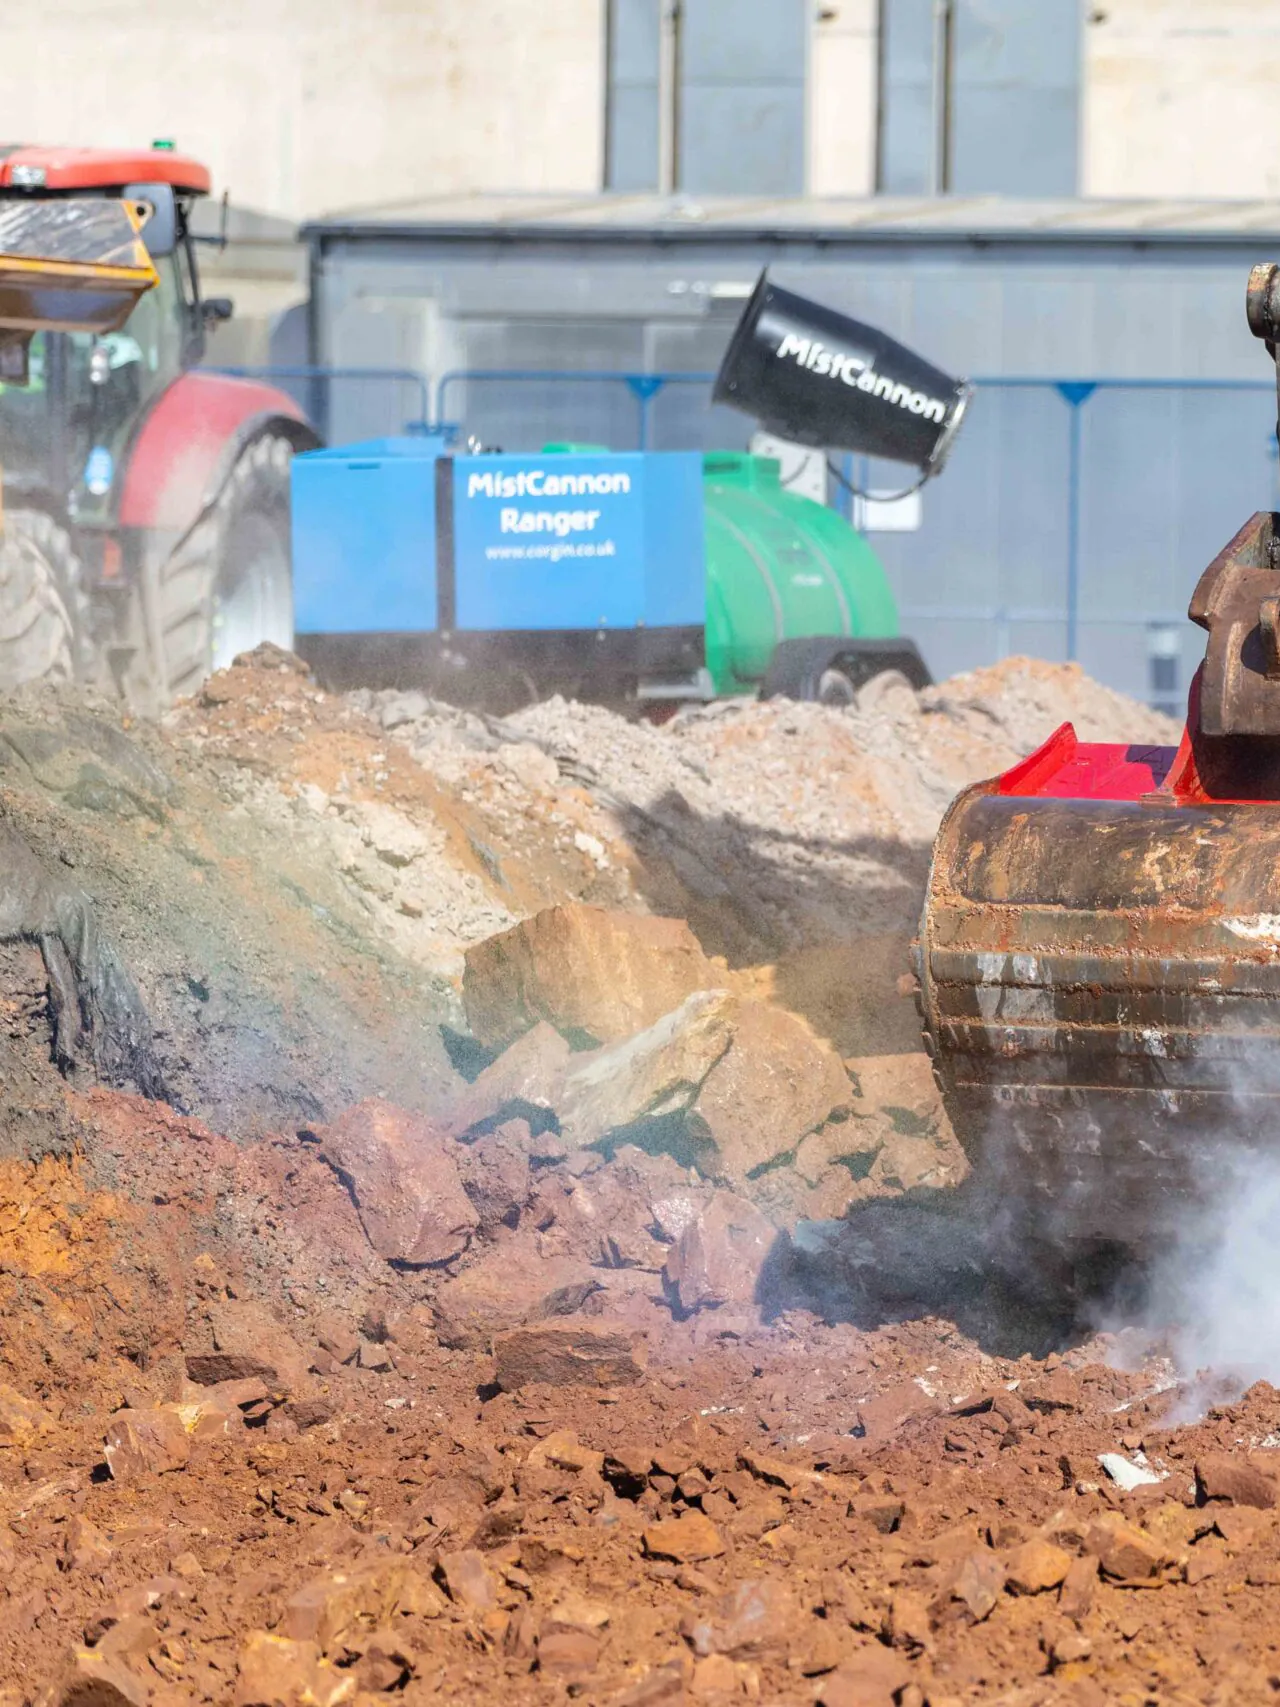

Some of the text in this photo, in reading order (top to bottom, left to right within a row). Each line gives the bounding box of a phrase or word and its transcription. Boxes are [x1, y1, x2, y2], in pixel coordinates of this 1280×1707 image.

[776, 333, 947, 424] MistCannon
[467, 471, 631, 498] MistCannon
[500, 506, 601, 537] Ranger
